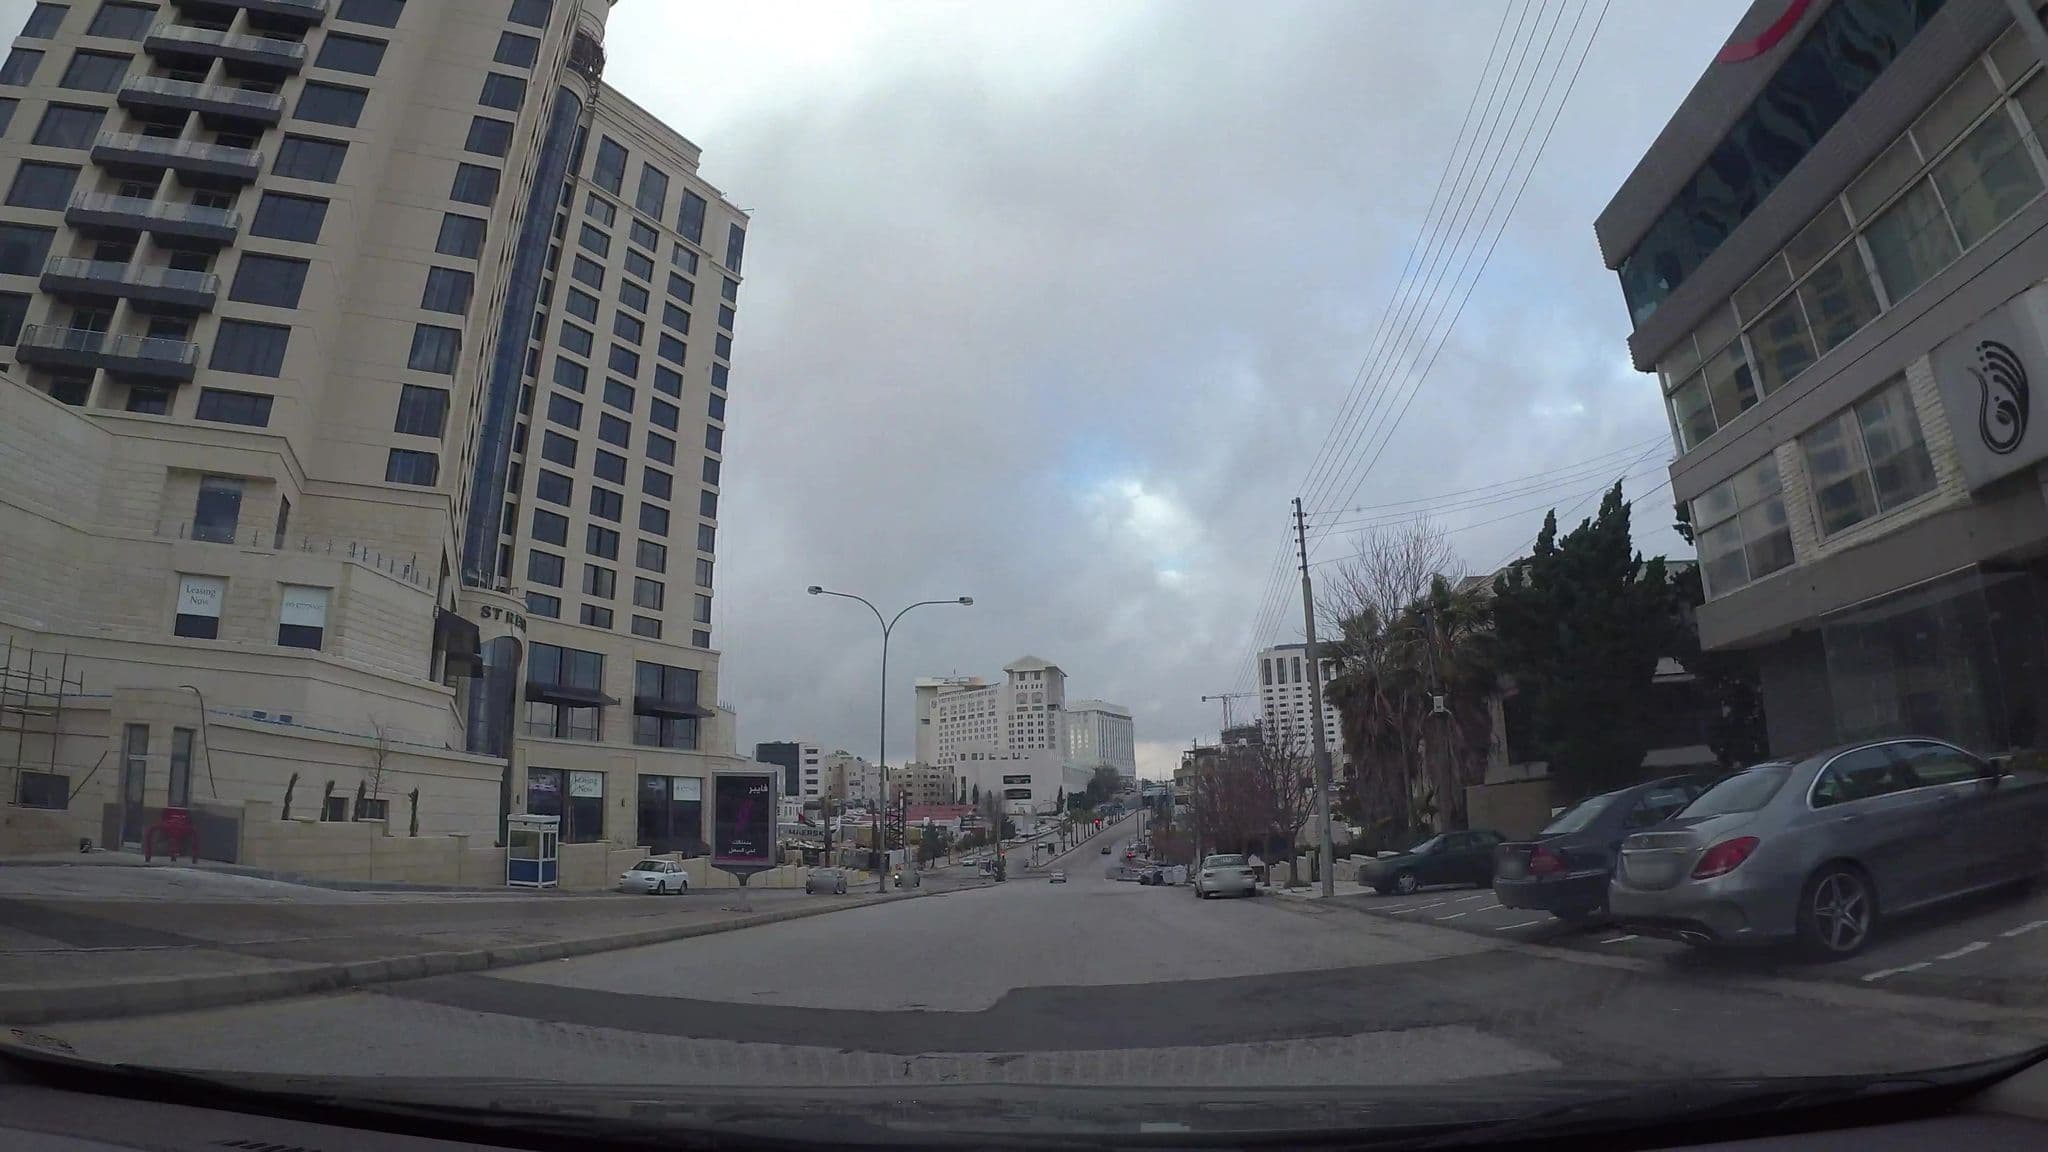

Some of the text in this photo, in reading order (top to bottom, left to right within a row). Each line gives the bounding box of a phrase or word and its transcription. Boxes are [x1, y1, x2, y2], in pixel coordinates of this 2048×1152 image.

[186, 584, 217, 599] Leasing
[190, 595, 209, 606] Now
[481, 605, 503, 620] ST
[748, 783, 769, 794] فايبر
[788, 827, 825, 837] MAERSK
